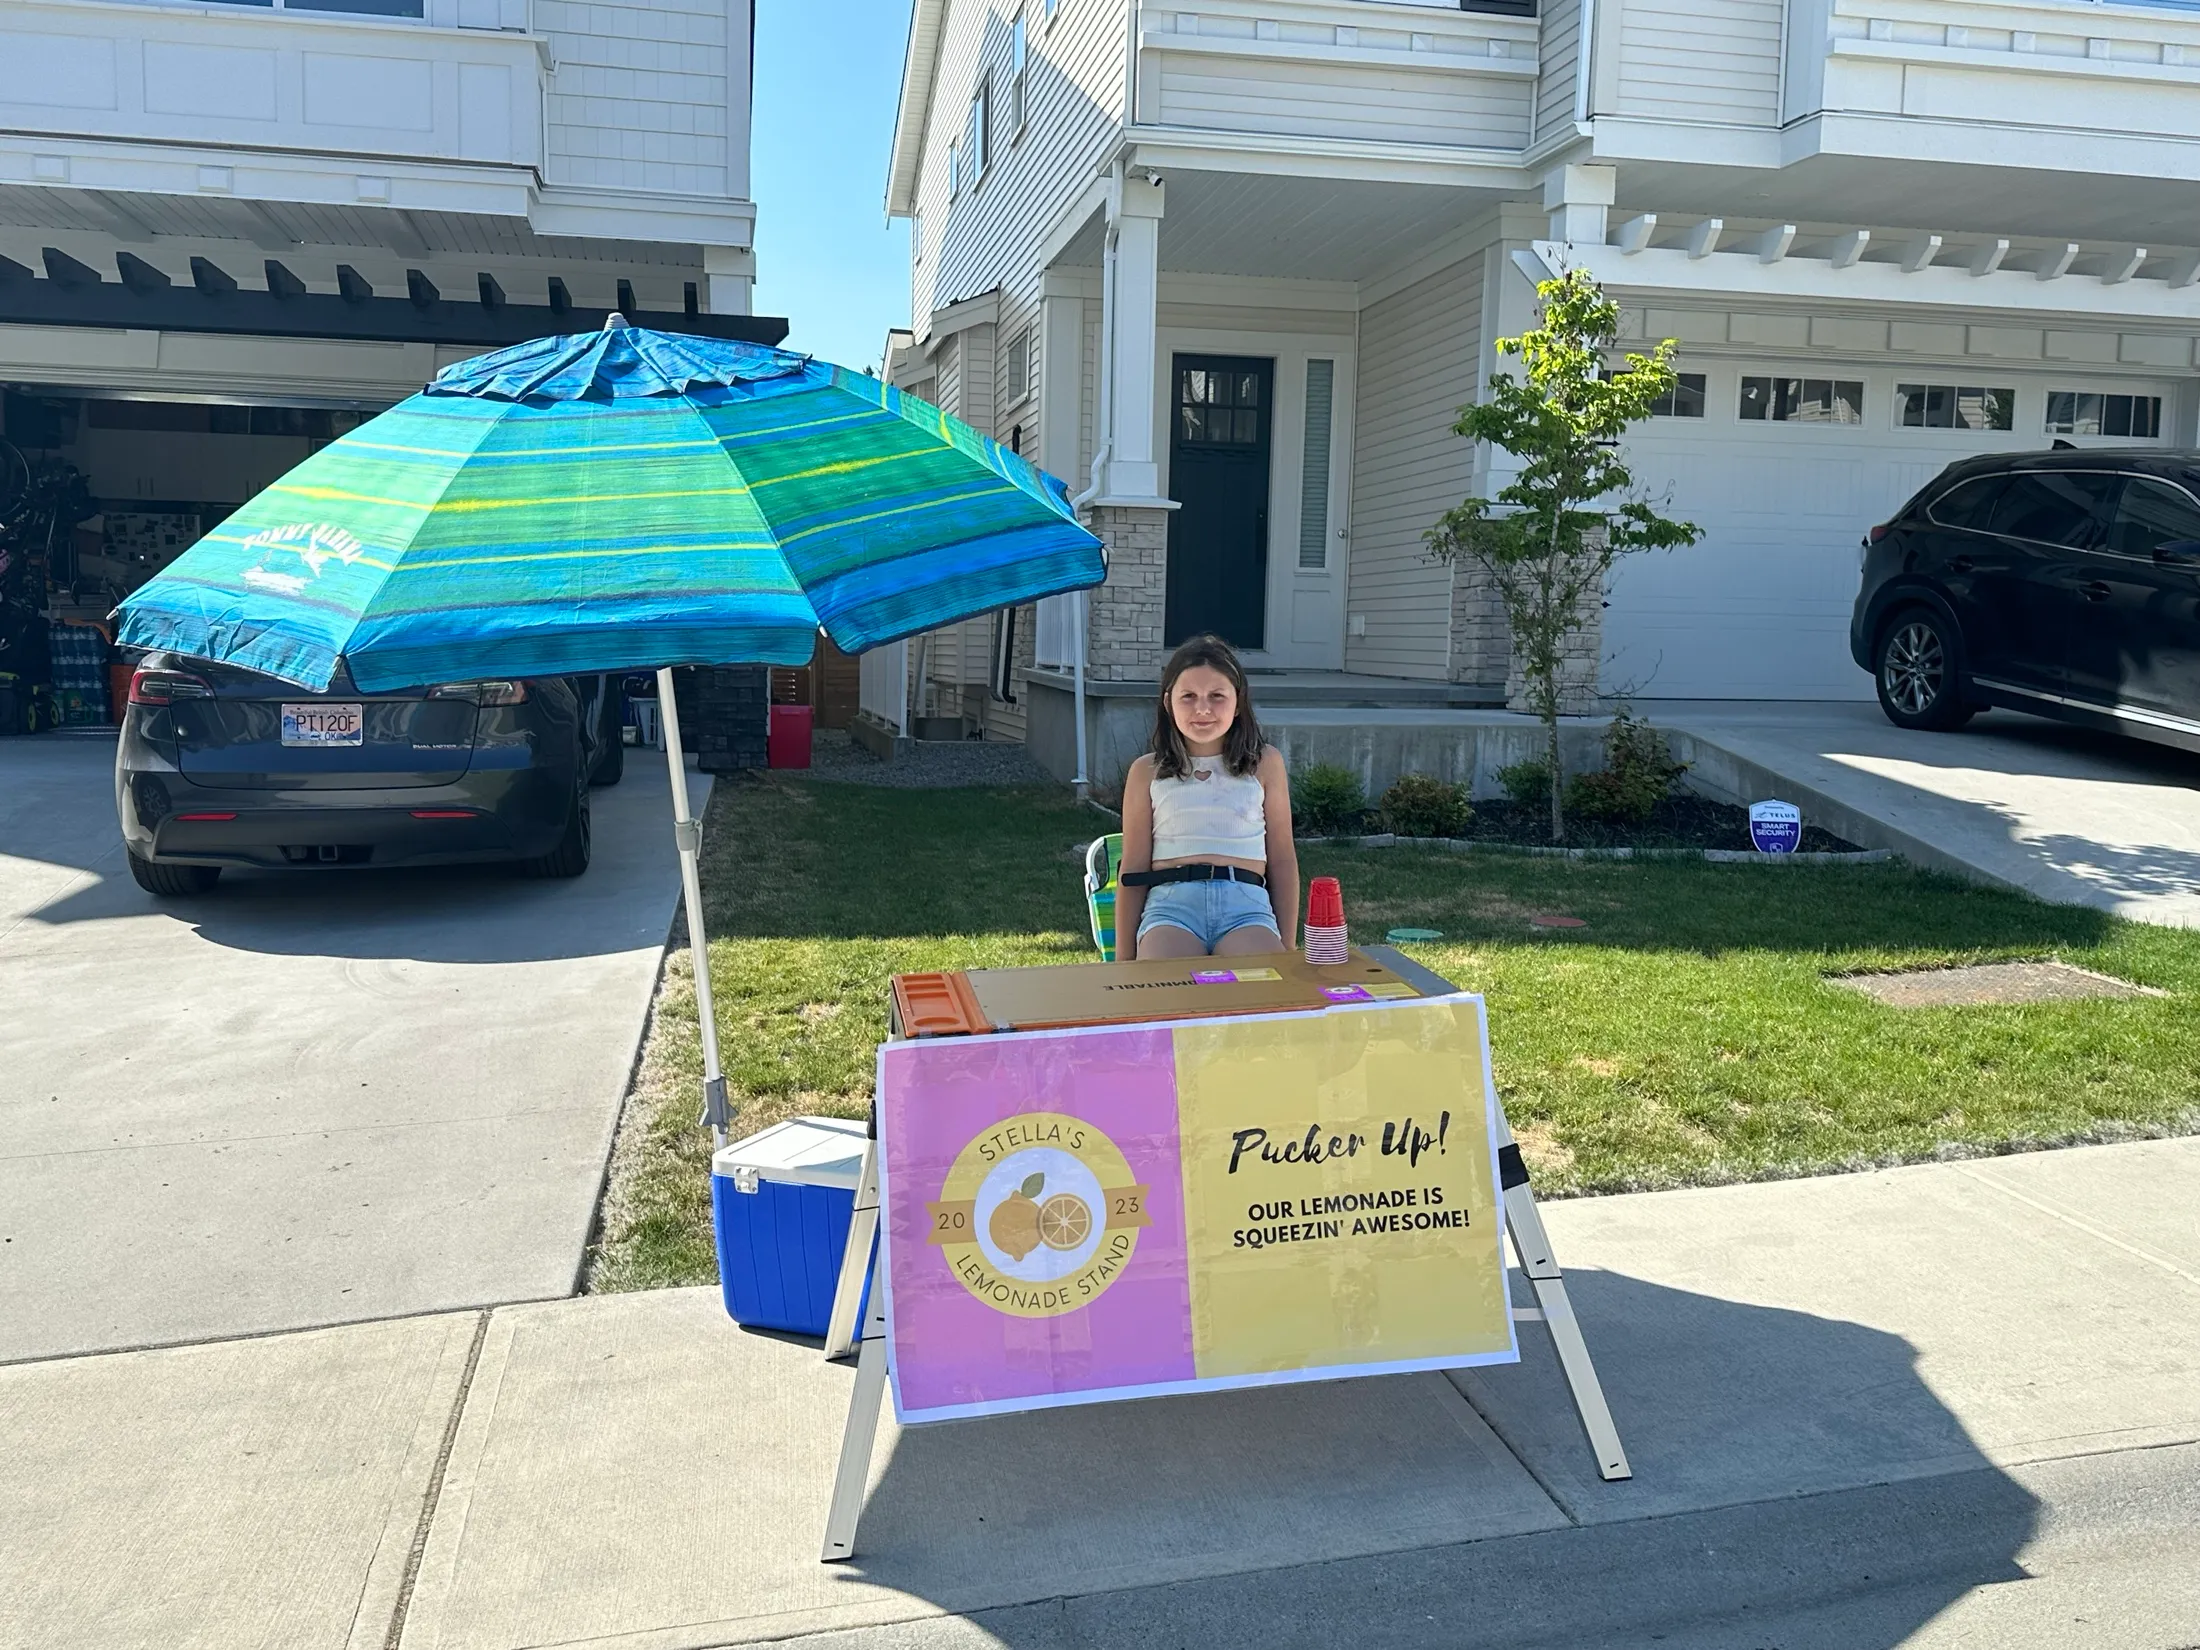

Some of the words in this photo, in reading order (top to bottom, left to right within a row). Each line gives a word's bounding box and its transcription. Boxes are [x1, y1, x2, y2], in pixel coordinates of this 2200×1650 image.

[243, 523, 315, 551] TOMMY
[296, 714, 358, 732] PT120F
[1756, 829, 1796, 837] SECURITY
[1761, 822, 1790, 830] SMART
[979, 1123, 1085, 1161] STELLA'S
[1228, 1123, 1367, 1175] Pucker
[1381, 1110, 1450, 1168] Up!
[938, 1212, 965, 1230] 20
[1115, 1196, 1139, 1214] 23
[1248, 1200, 1295, 1222] OUR
[1301, 1189, 1417, 1217] LEMONADE
[1423, 1187, 1444, 1205] IS
[1233, 1219, 1344, 1250] SQUEEZIN'
[1351, 1209, 1470, 1236] AWESOME!
[956, 1254, 1071, 1309] LEMONADE
[1077, 1234, 1130, 1295] STAND
